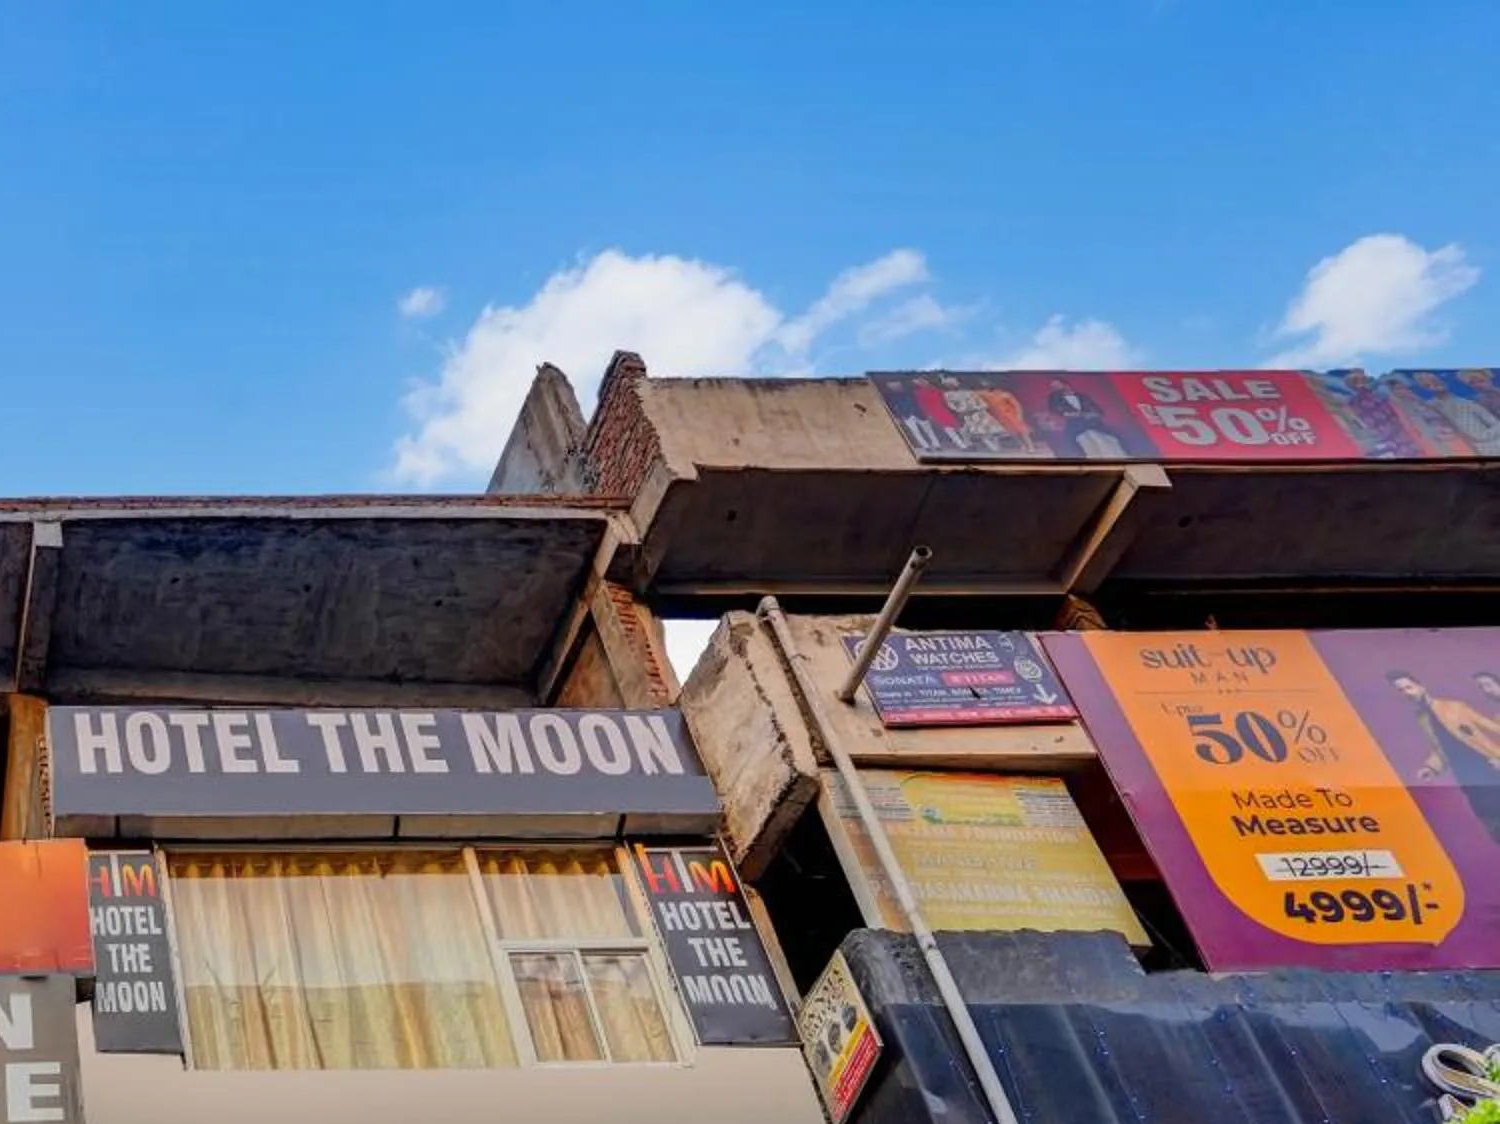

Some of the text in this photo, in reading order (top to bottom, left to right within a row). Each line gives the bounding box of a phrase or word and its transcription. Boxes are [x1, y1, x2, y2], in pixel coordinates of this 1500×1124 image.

[1142, 377, 1281, 401] SALE
[1155, 404, 1312, 446] 50%
[1270, 432, 1316, 446] OFF
[904, 636, 992, 651] ANTIMA
[909, 650, 999, 665] WATCHES
[74, 710, 686, 777] HOTEL THE MOON
[1187, 709, 1328, 765] 50%
[1232, 785, 1353, 810] Made To
[1232, 814, 1381, 837] Measure
[88, 905, 162, 936] HOTEL
[658, 900, 750, 931] HOTEL
[108, 943, 153, 973] THE
[687, 937, 748, 967] THE
[96, 980, 167, 1013] MOON
[682, 974, 778, 1010] MOON
